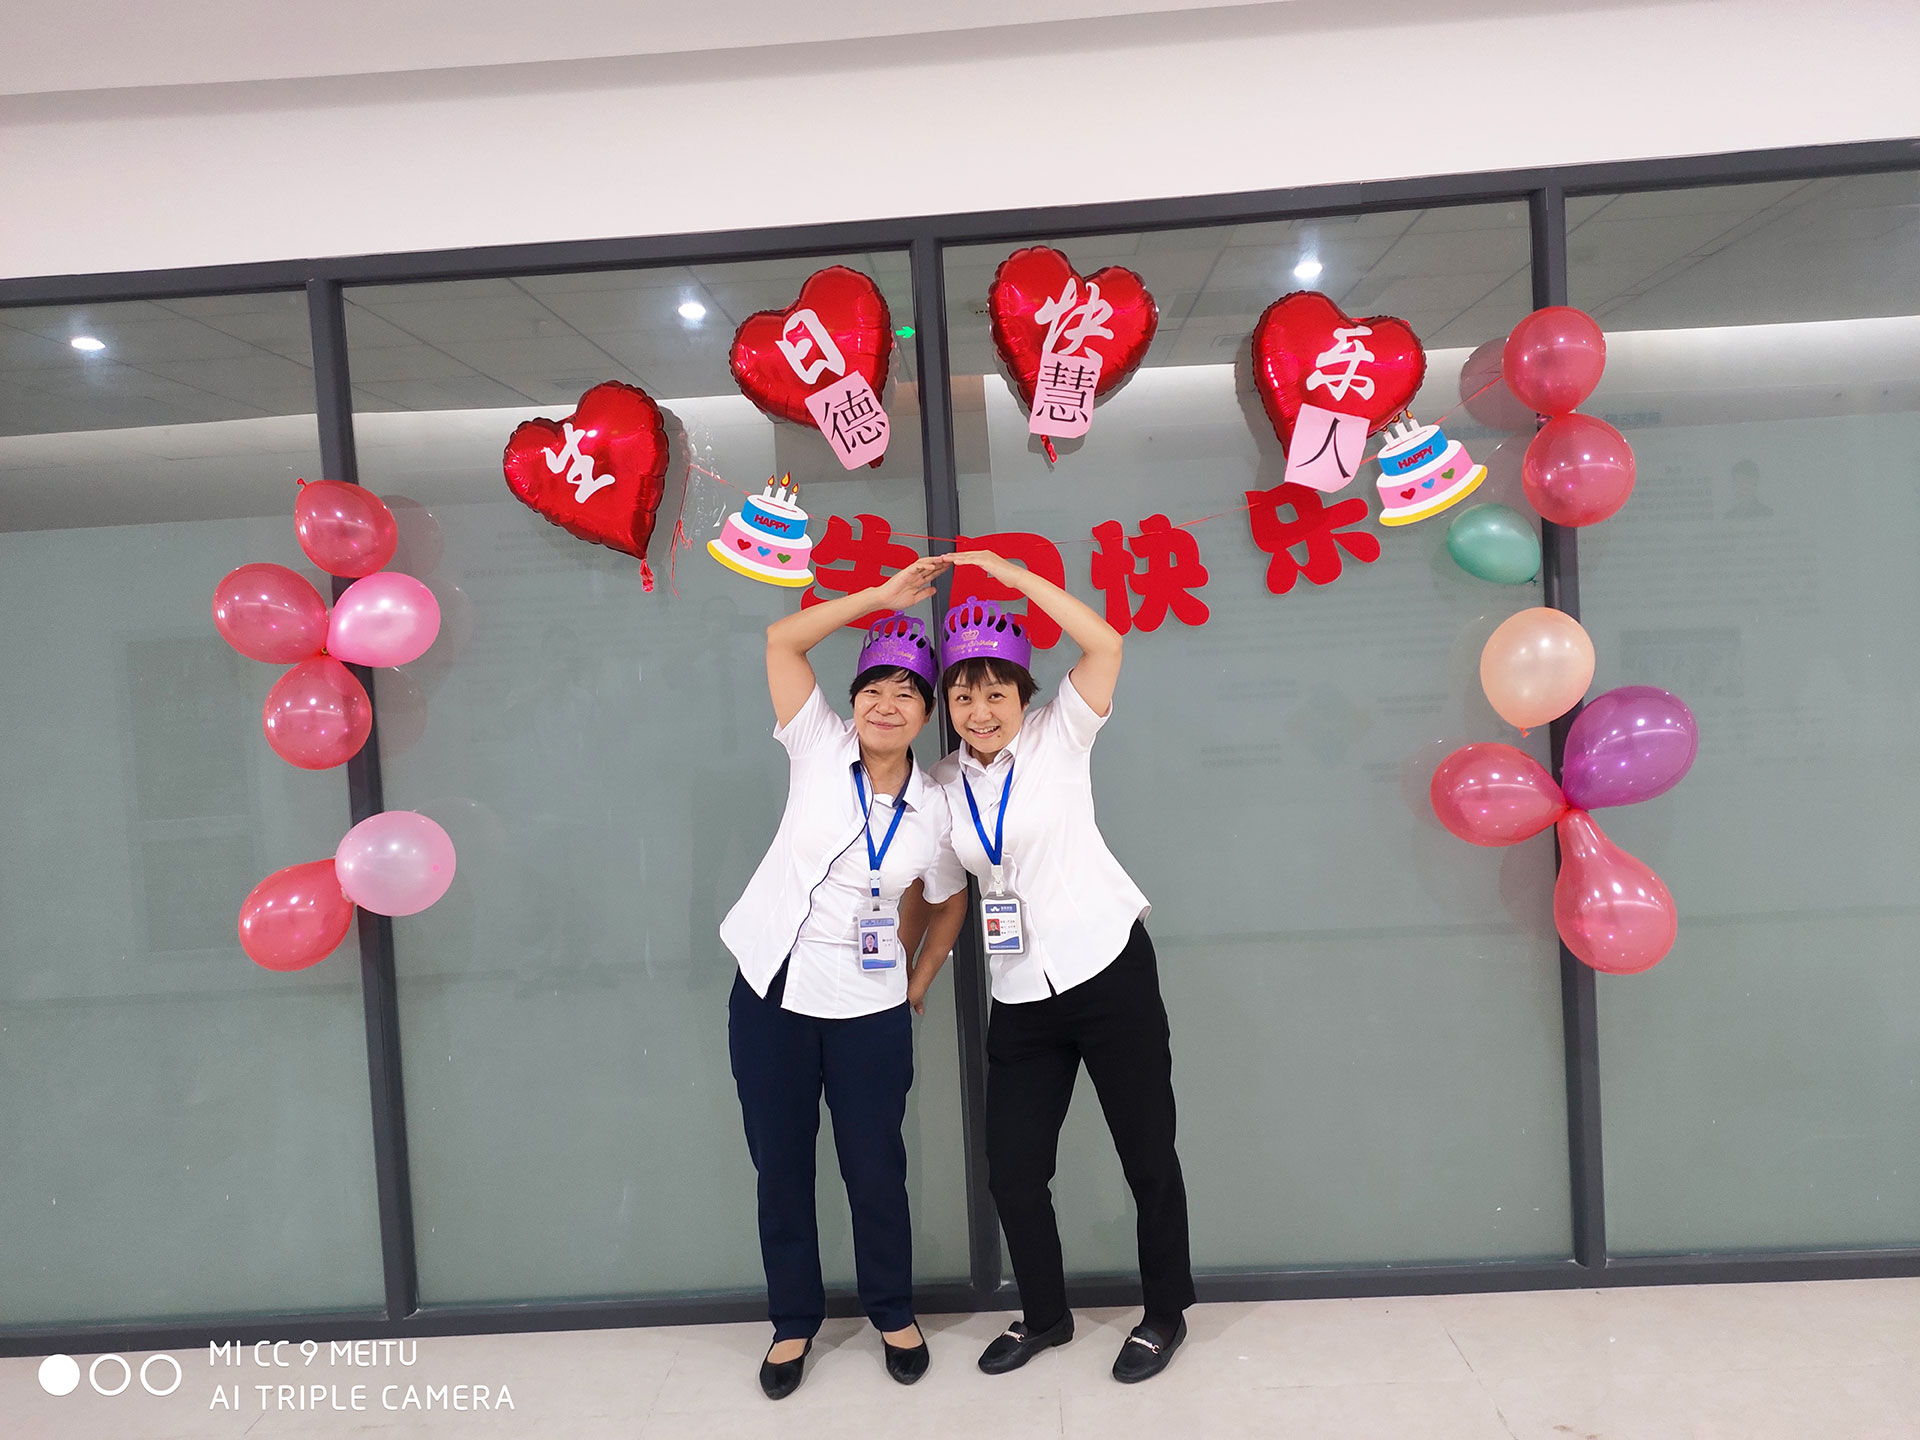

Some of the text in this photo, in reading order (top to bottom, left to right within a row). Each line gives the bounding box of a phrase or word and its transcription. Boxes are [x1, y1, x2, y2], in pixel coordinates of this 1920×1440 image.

[775, 308, 847, 385] 日
[1034, 277, 1114, 368] 快
[823, 388, 886, 455] 德
[1036, 360, 1097, 424] 慧
[540, 422, 616, 504] 生
[1295, 416, 1352, 479] 人
[1397, 444, 1433, 470] HAPPY
[754, 513, 791, 533] HAPPY
